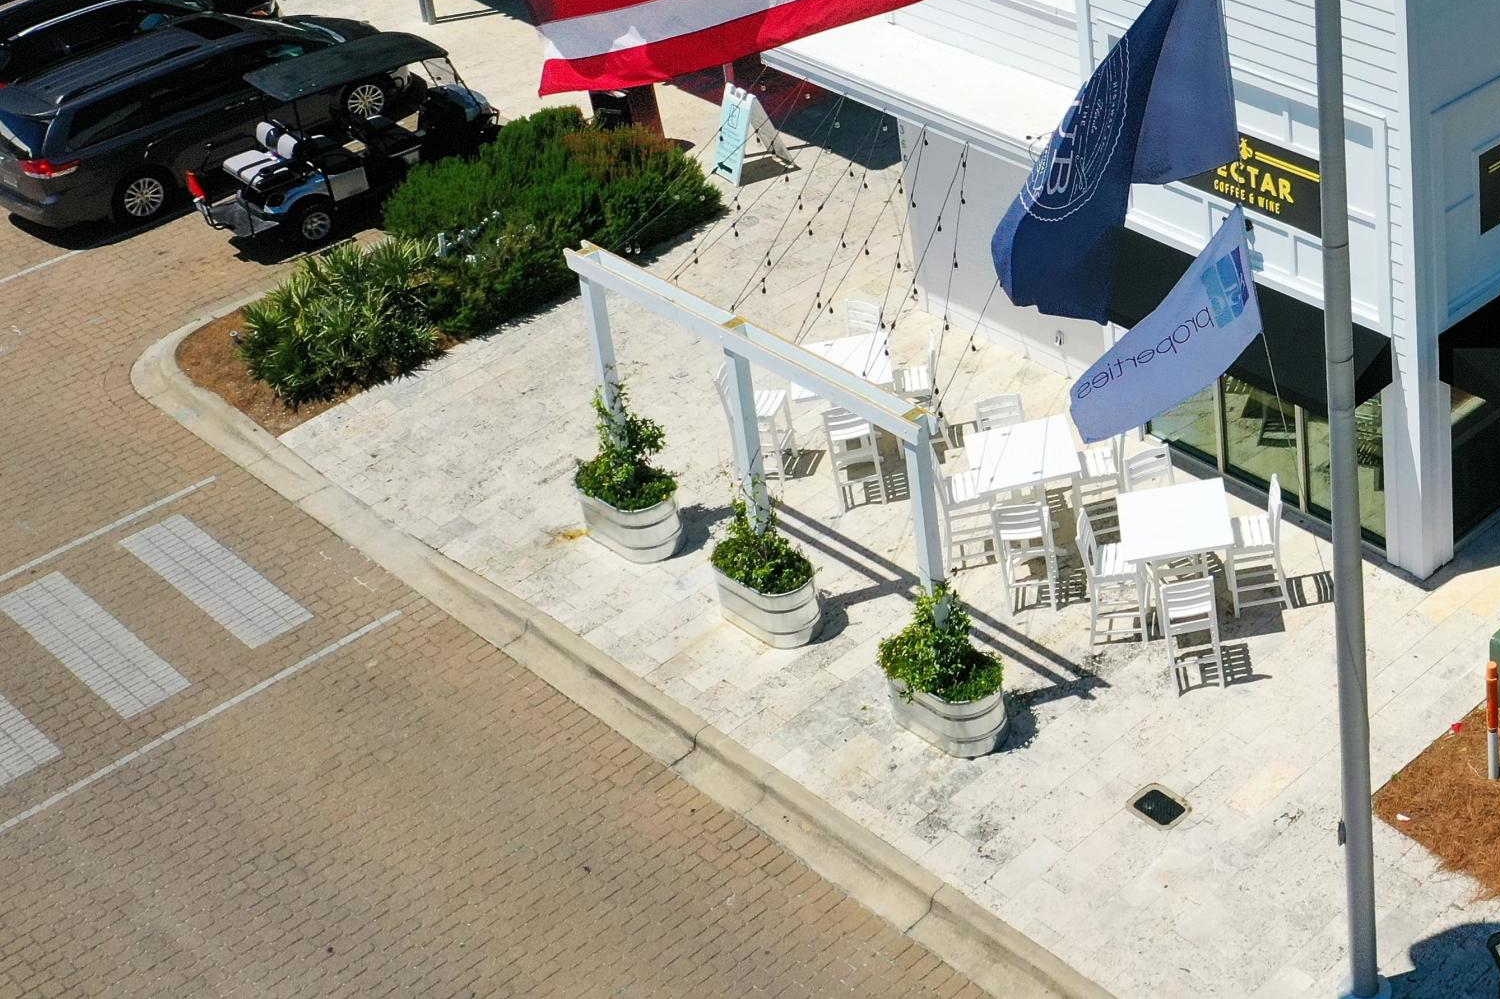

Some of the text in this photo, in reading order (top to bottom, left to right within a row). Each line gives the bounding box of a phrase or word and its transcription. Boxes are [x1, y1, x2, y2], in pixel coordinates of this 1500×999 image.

[1046, 94, 1085, 195] UB
[1213, 179, 1281, 215] COFFEE & WINE
